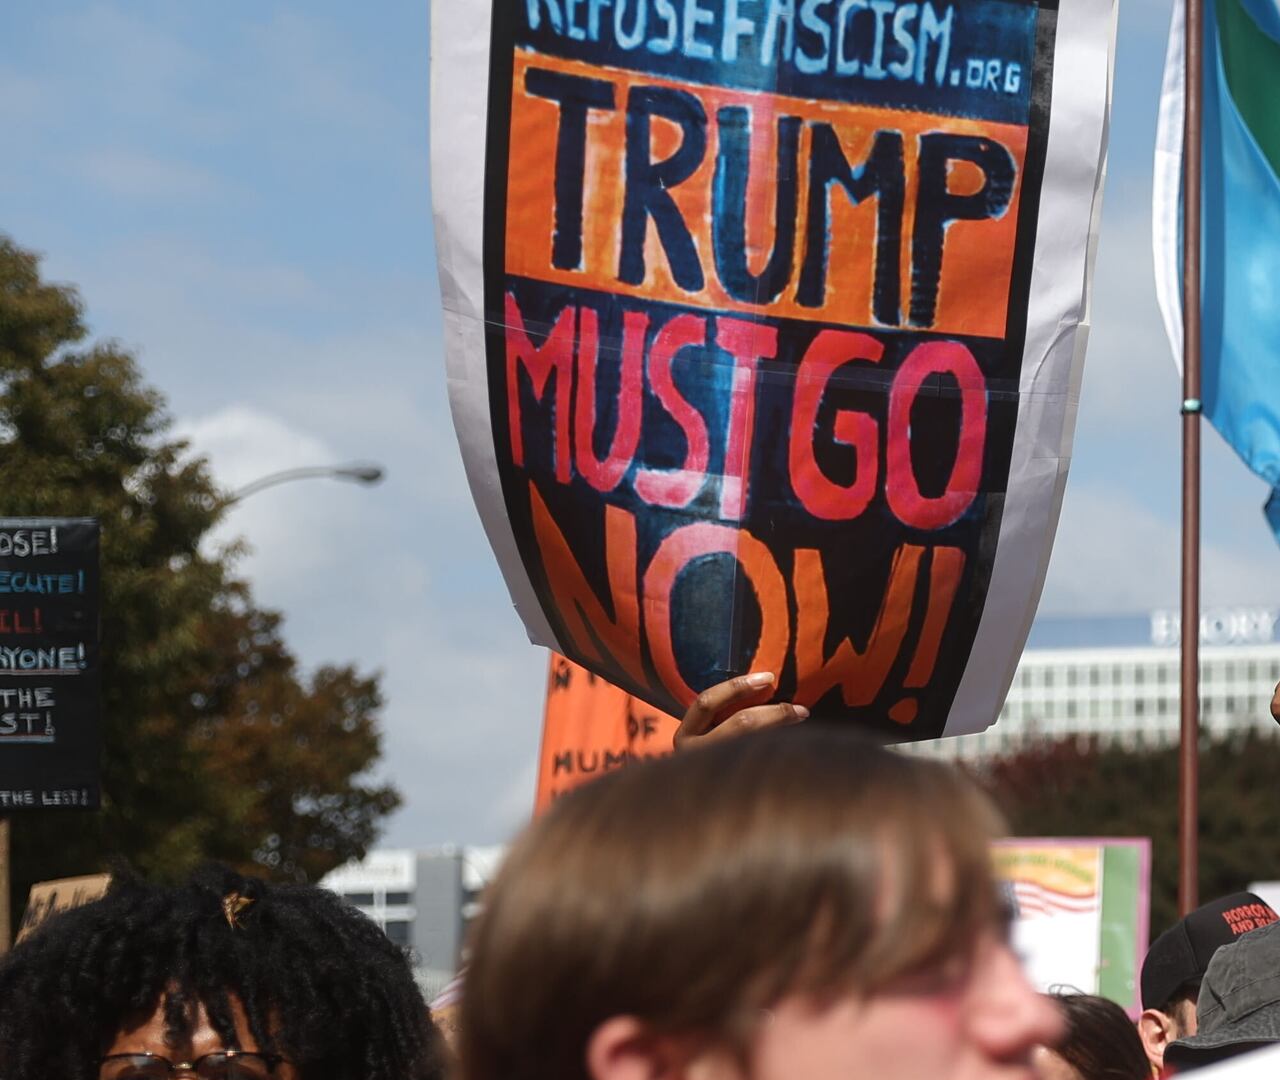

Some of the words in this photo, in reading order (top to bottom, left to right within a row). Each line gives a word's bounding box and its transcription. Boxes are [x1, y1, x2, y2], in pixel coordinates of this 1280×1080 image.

[524, 66, 1018, 330] TRUMP
[505, 292, 778, 520] MUST
[788, 328, 990, 531] GO
[528, 480, 966, 725] NOW!
